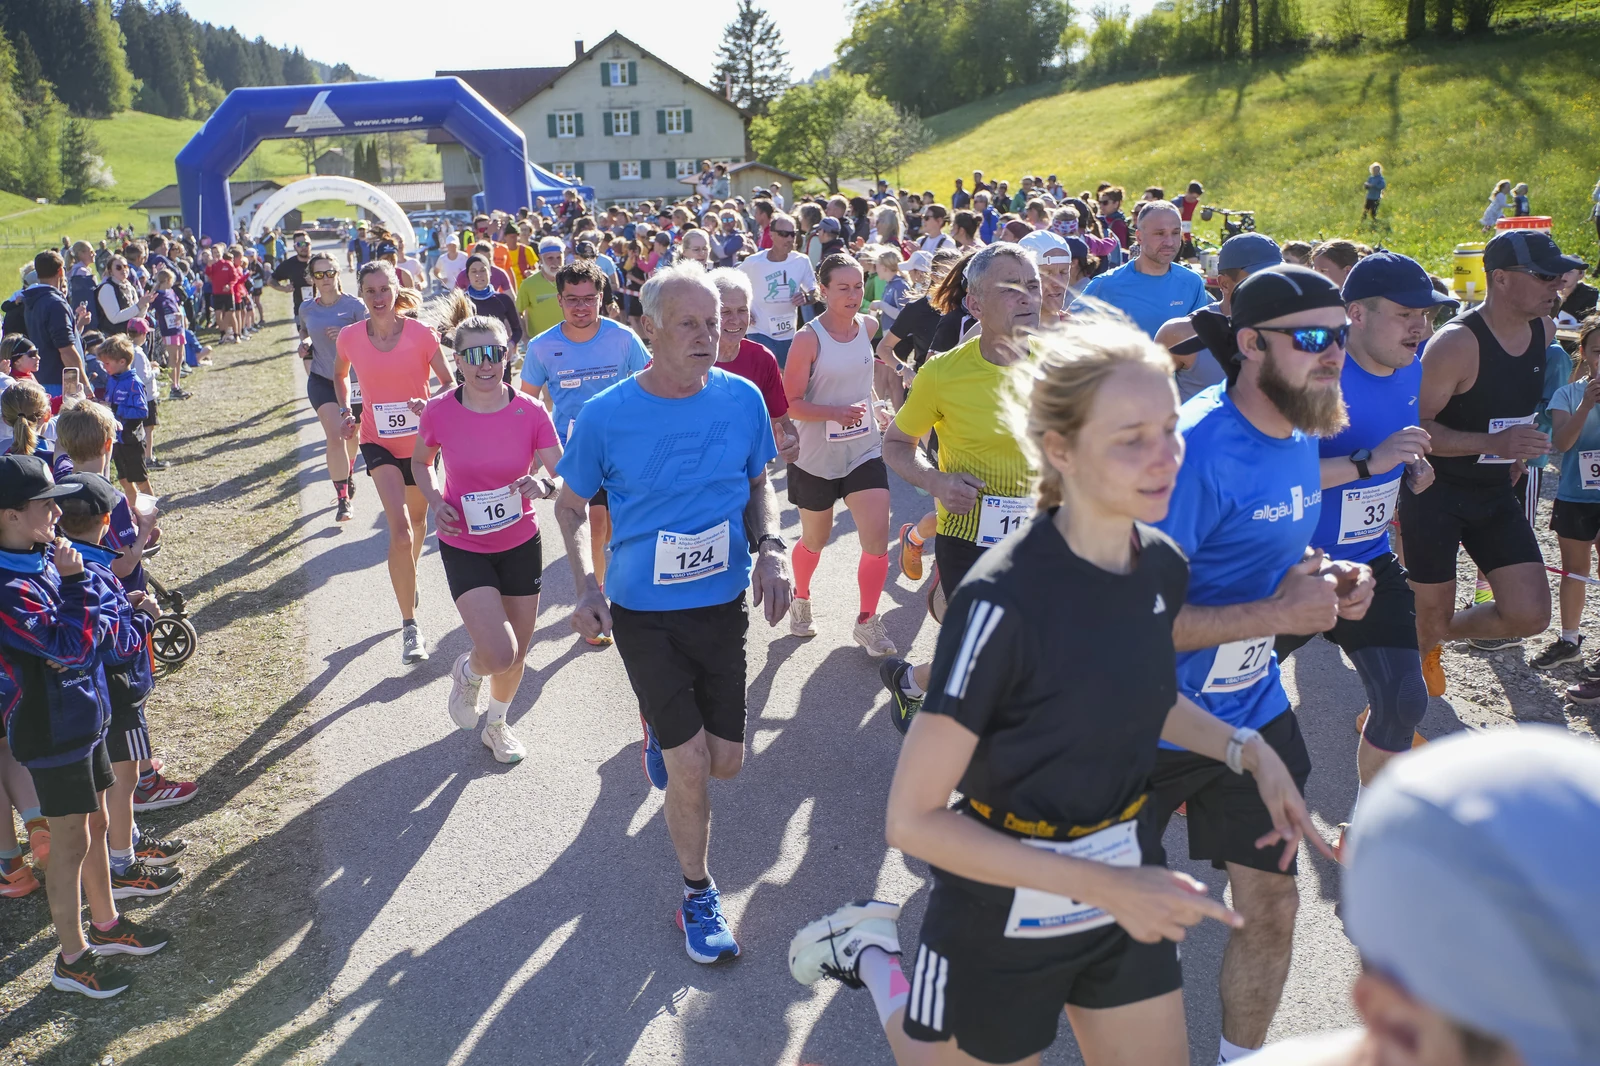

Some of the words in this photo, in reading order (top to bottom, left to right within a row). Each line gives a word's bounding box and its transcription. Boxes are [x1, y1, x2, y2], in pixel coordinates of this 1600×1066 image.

[353, 115, 424, 127] www.sv-mg.de
[776, 320, 791, 331] 105
[388, 414, 406, 428] 59
[484, 503, 505, 520] 16
[1252, 502, 1292, 522] allgäu
[1364, 502, 1386, 526] 33
[1000, 516, 1029, 534] 11
[676, 546, 714, 570] 124
[1238, 640, 1267, 672] 27
